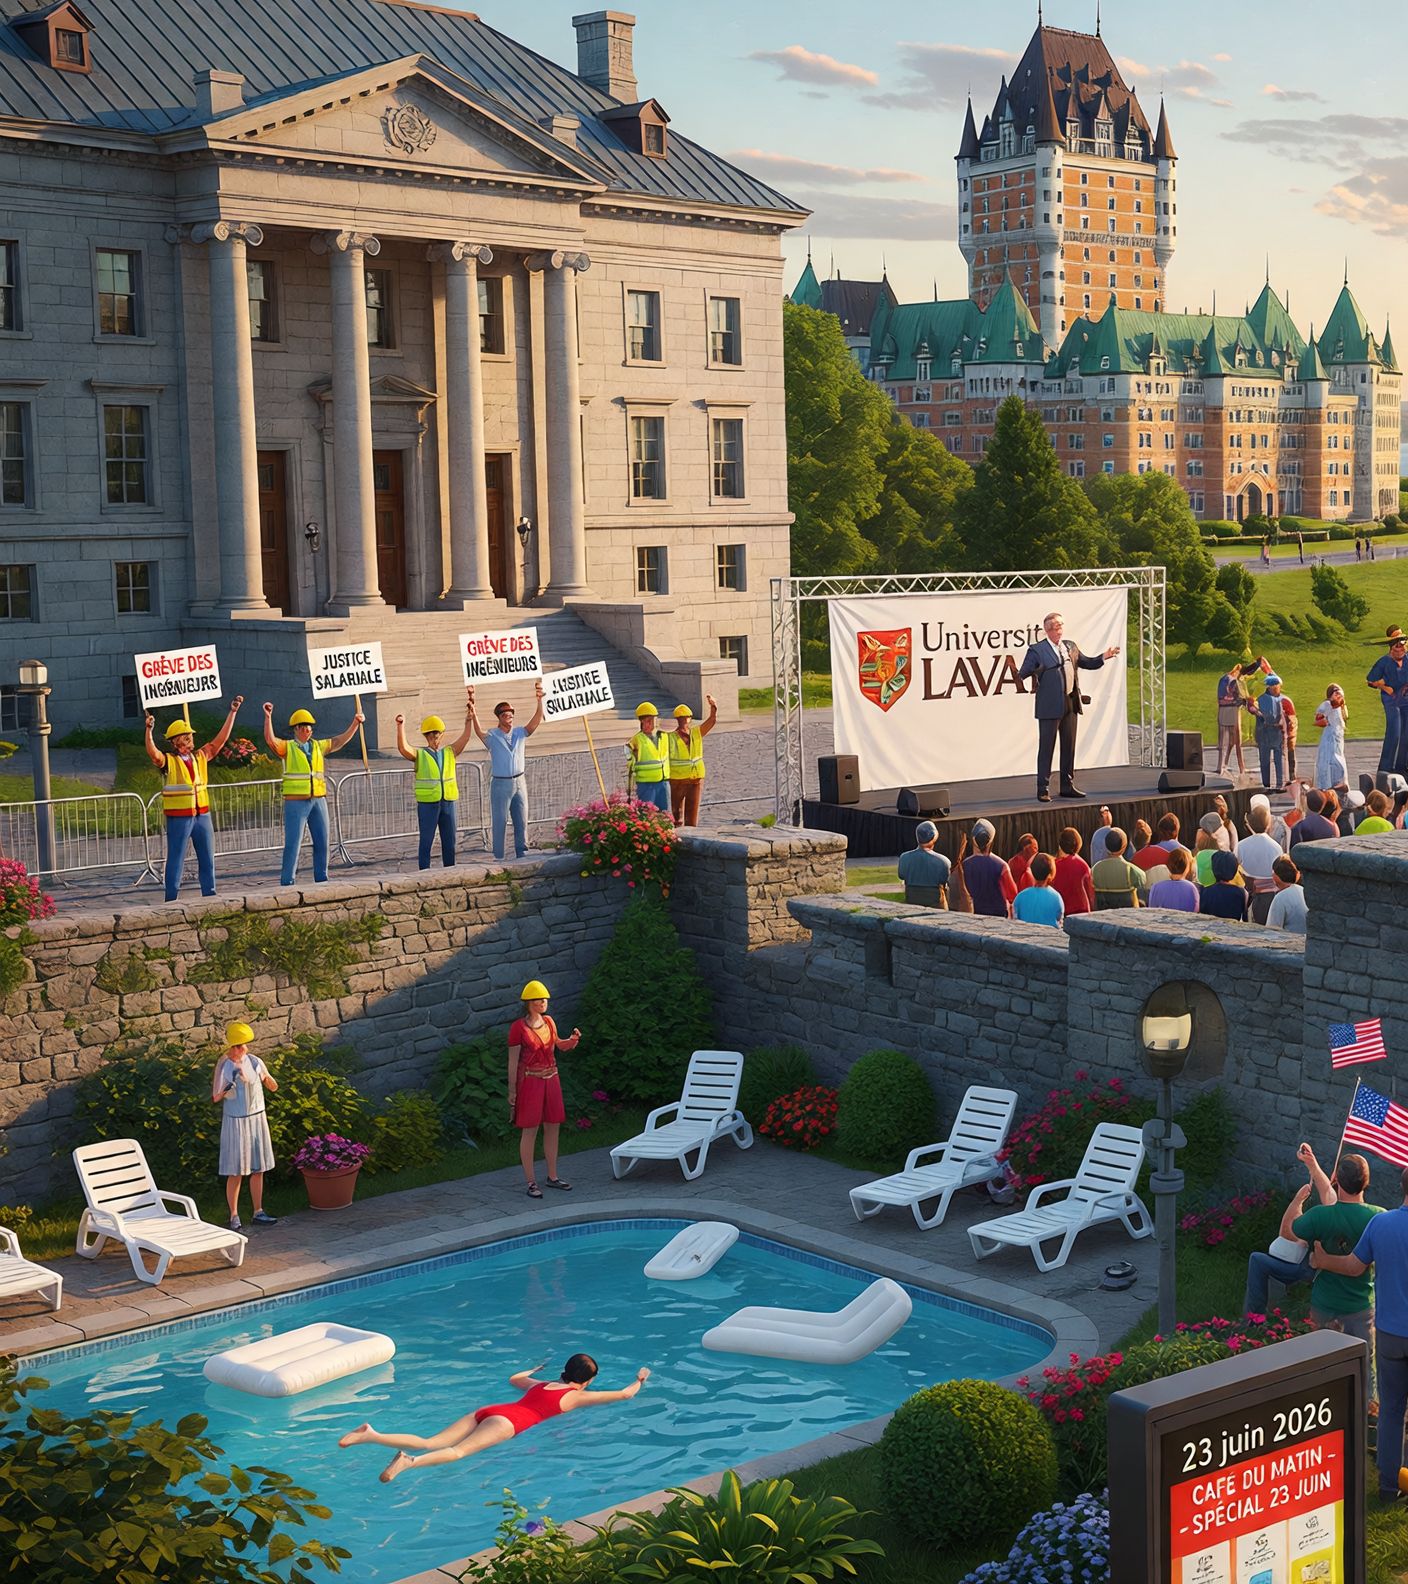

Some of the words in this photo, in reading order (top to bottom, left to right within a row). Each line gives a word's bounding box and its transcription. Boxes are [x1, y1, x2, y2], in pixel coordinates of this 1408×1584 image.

[510, 636, 533, 652] DES
[920, 621, 1043, 652] Universit
[187, 653, 213, 672] DES
[322, 650, 371, 670] JUSTICE
[315, 669, 383, 690] SALARIALE
[921, 654, 1037, 701] LAVA
[1181, 1437, 1212, 1473] 23
[1218, 1422, 1265, 1468] juin
[1272, 1397, 1333, 1442] 2026
[1192, 1471, 1237, 1506] CAFÉ
[1242, 1466, 1265, 1490] DU
[1270, 1444, 1322, 1481] MATIN
[1192, 1497, 1264, 1535] SPÉCIAL
[1269, 1486, 1290, 1508] 23
[1294, 1470, 1332, 1501] JUIN
